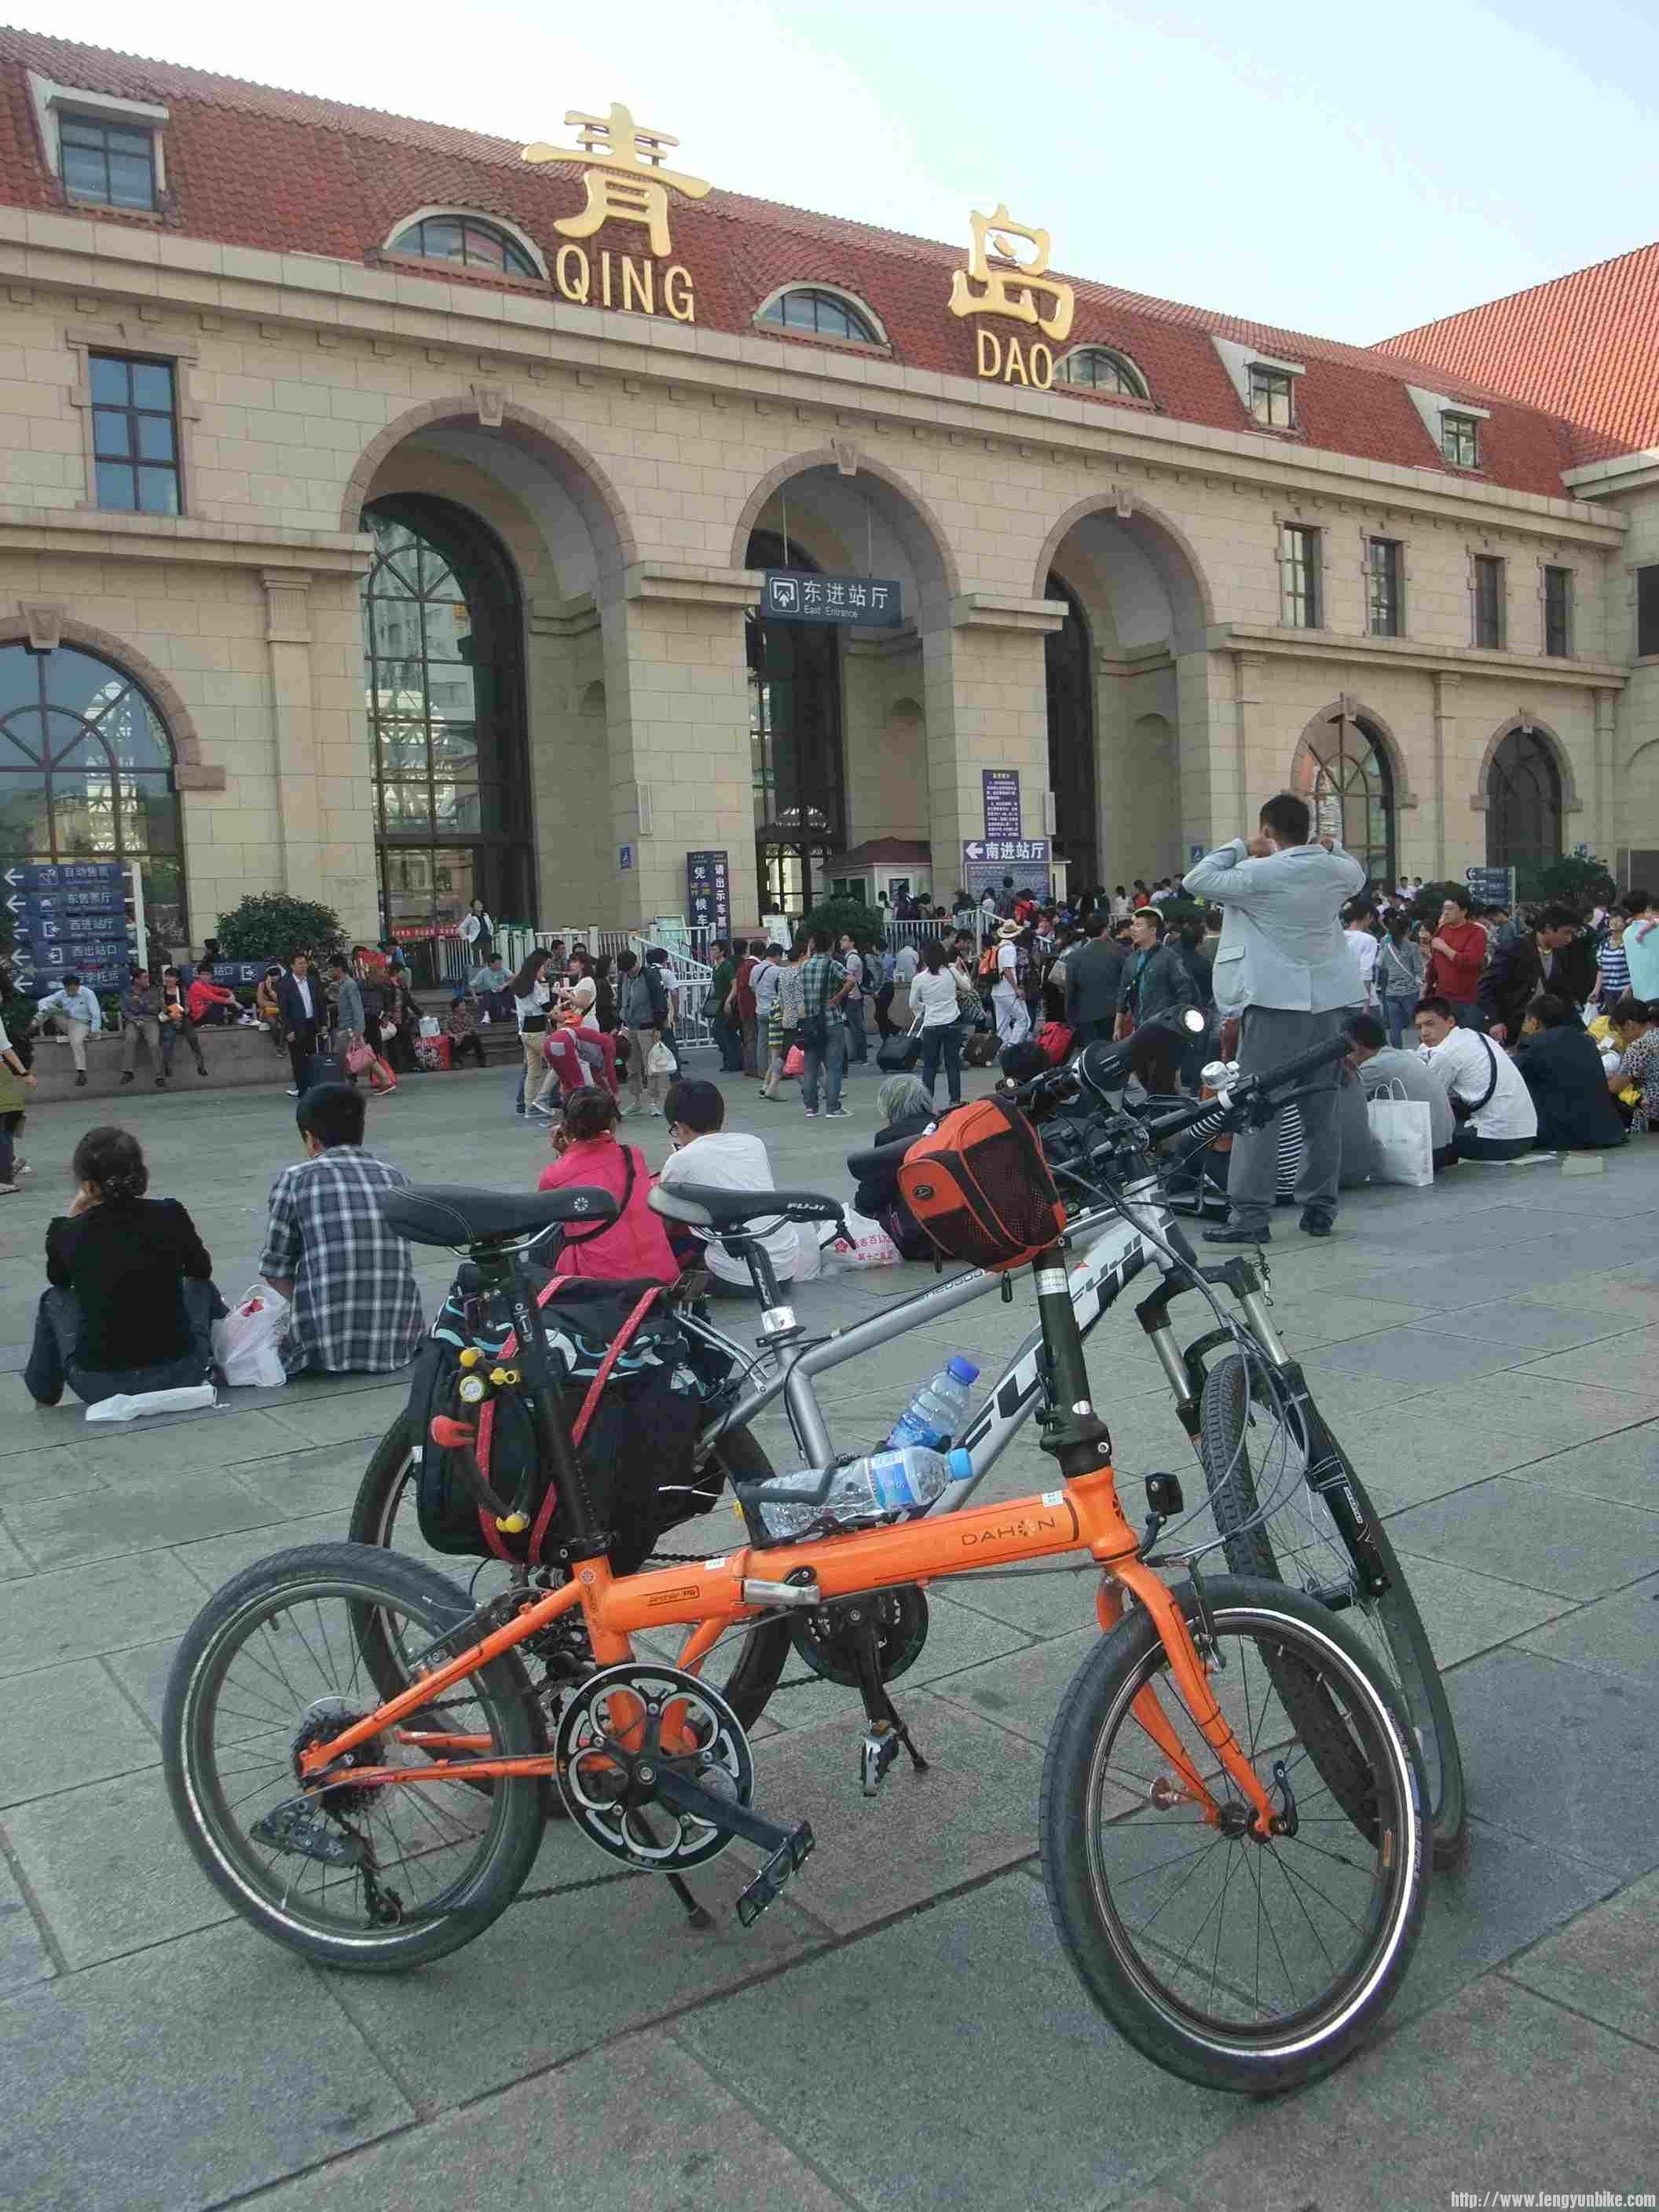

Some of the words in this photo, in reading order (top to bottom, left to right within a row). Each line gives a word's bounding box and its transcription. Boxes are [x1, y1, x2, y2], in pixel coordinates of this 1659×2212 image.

[522, 102, 711, 258] 青
[949, 203, 1075, 341] 岛
[556, 244, 695, 323] QING
[976, 329, 1054, 390] DAO
[803, 580, 888, 609] 东进站厅
[804, 605, 821, 616] East
[826, 606, 859, 619] Entrance
[984, 841, 1044, 860] 南进站厅
[715, 864, 727, 928] 请出示车票
[786, 1201, 826, 1211] FUJI
[961, 1517, 1057, 1546] DAHON
